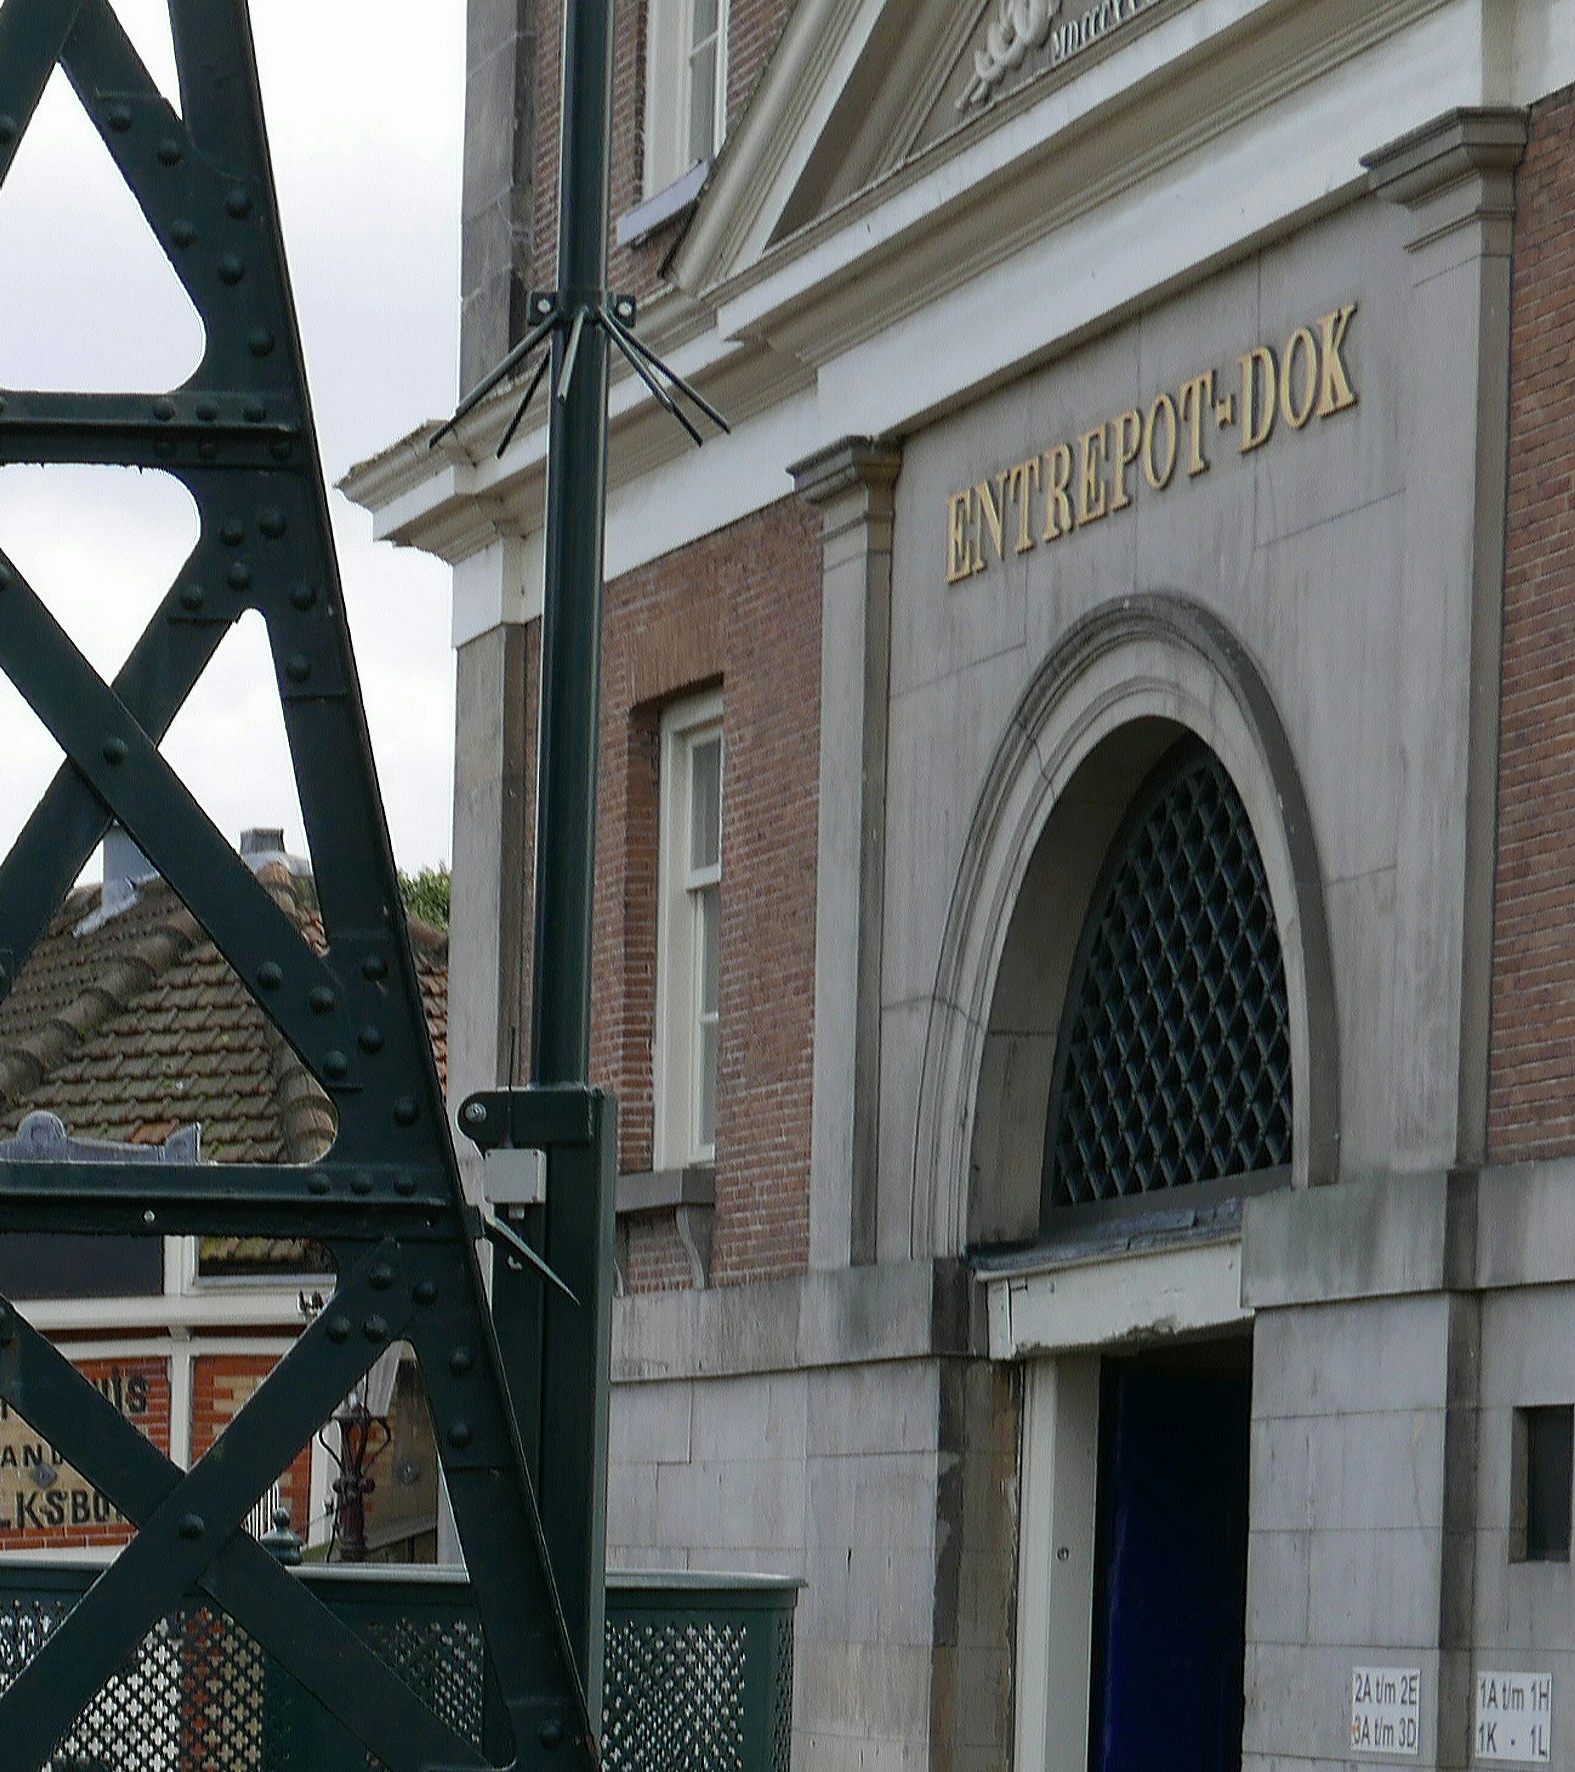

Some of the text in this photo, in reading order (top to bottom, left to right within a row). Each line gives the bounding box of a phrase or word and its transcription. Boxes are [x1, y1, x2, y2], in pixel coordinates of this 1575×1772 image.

[947, 303, 1358, 584] ENTREPOT-DOK
[1355, 1673, 1418, 1706] 2A t/m 2E
[1479, 1679, 1550, 1711] 1A t/m 1H
[1353, 1716, 1417, 1748] 3A t/m 3D
[1479, 1721, 1497, 1753] 1K
[1530, 1724, 1548, 1758] 1L
